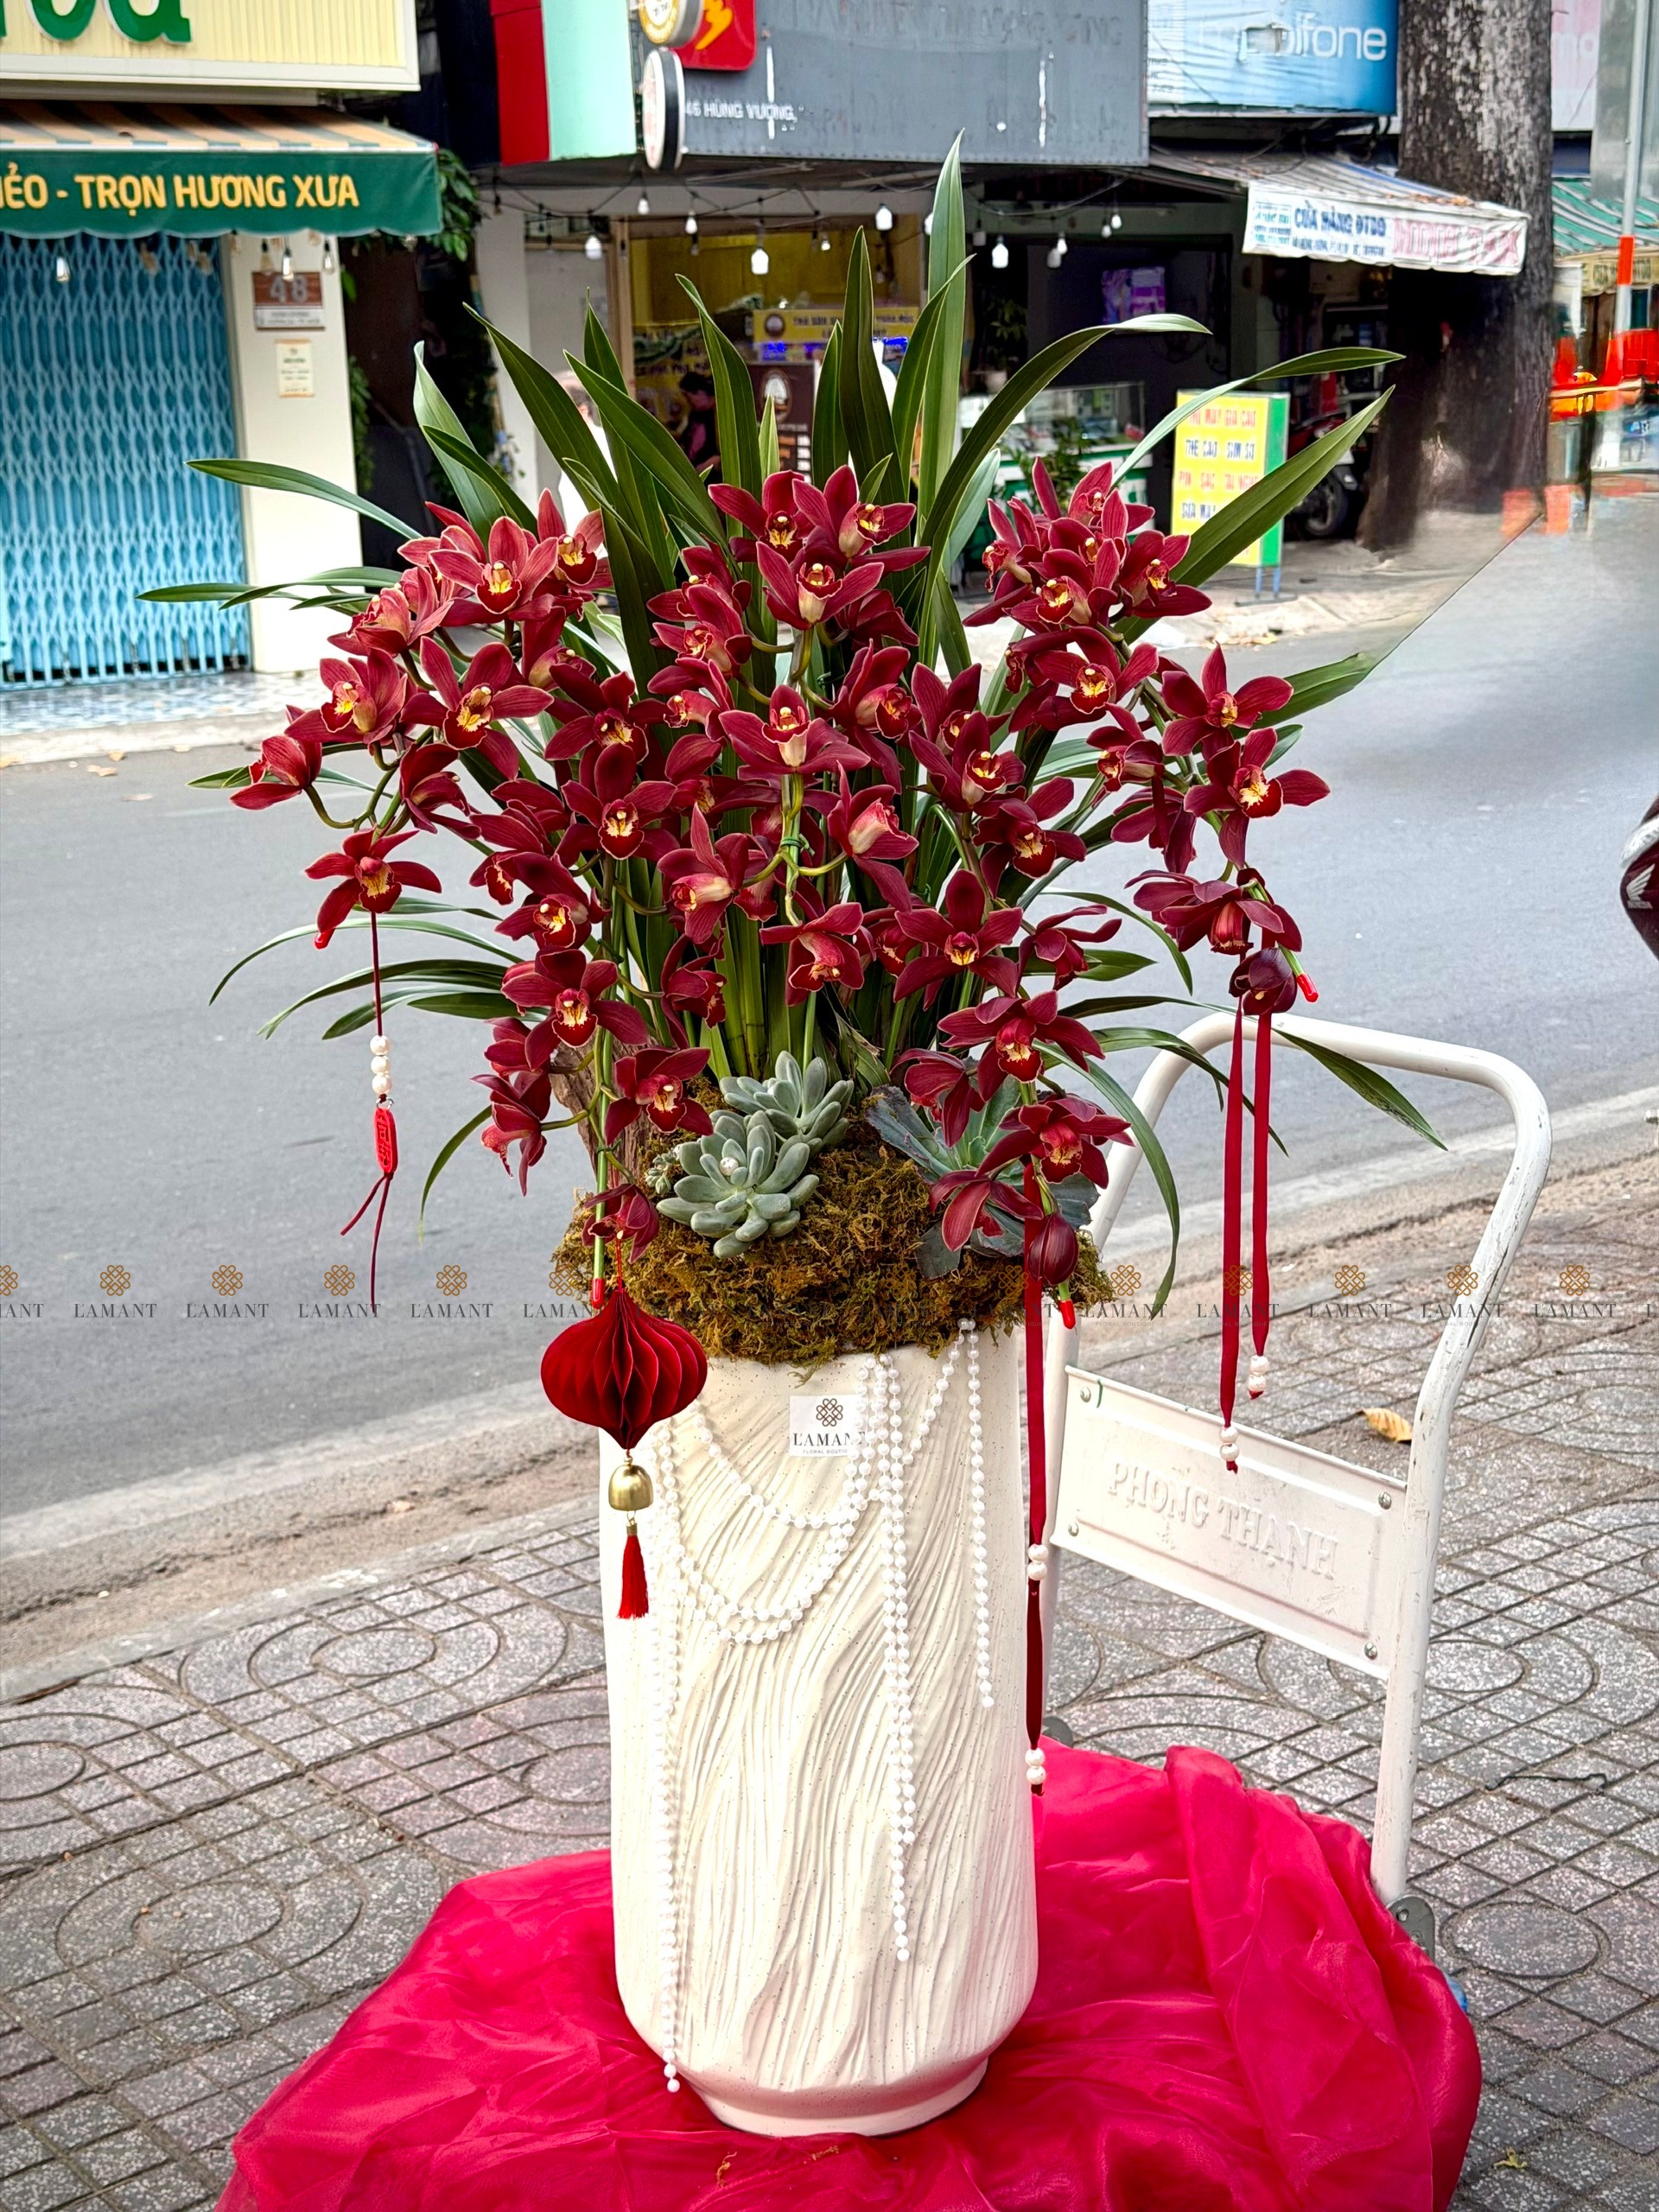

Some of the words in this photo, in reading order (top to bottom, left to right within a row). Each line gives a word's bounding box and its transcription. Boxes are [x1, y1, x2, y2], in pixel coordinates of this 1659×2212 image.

[0, 162, 48, 209] ẺO
[74, 175, 167, 217] TRỌN
[174, 175, 287, 208] HƯƠNG
[292, 175, 360, 208] XƯA
[793, 1431, 866, 1446] L'AMAN
